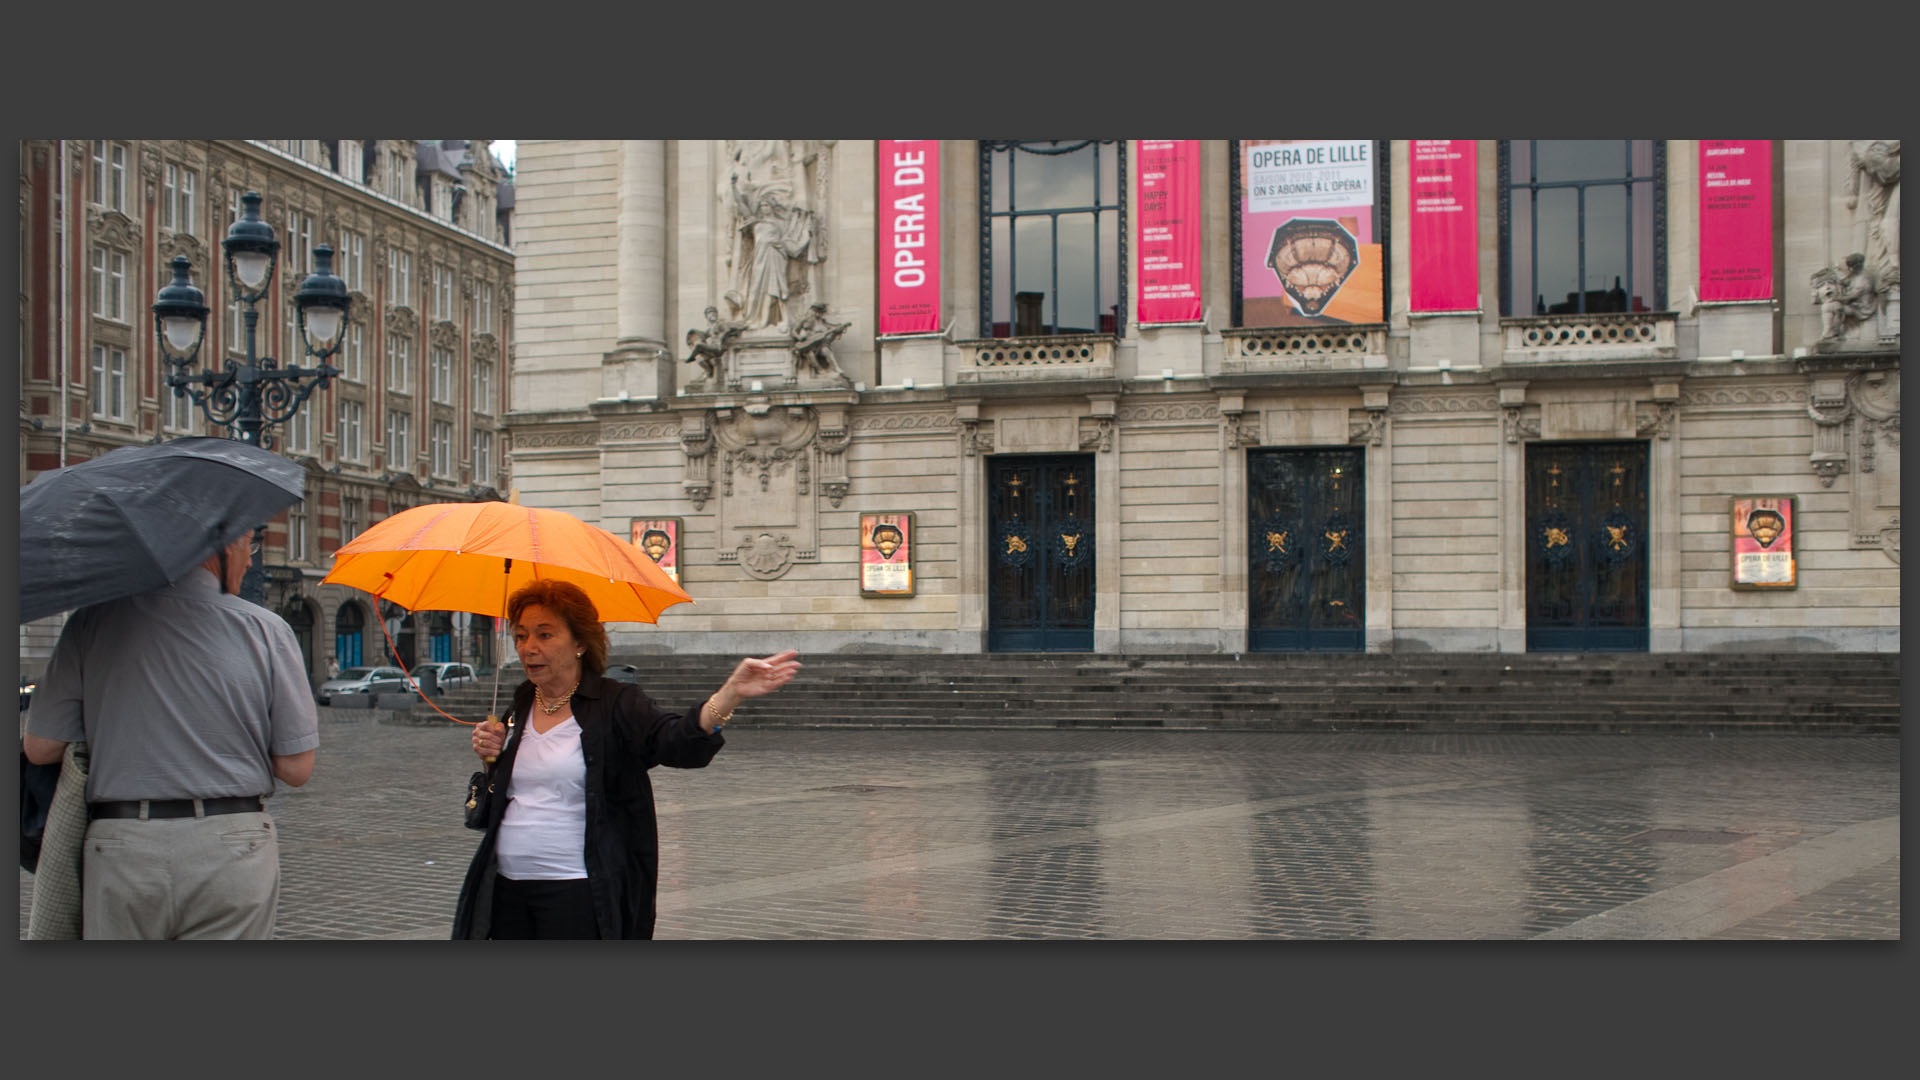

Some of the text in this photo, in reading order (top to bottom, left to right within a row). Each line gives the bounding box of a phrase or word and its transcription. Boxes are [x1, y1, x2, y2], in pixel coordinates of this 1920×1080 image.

[1253, 144, 1367, 168] OPERA DE LILLE
[894, 150, 926, 187] DE
[1253, 173, 1286, 185] SAISON
[1253, 187, 1266, 197] ON
[1268, 182, 1313, 196] S'ABONNE
[1315, 180, 1323, 192] À
[1323, 178, 1362, 192] L'OPÉRA
[894, 193, 926, 288] OPERA
